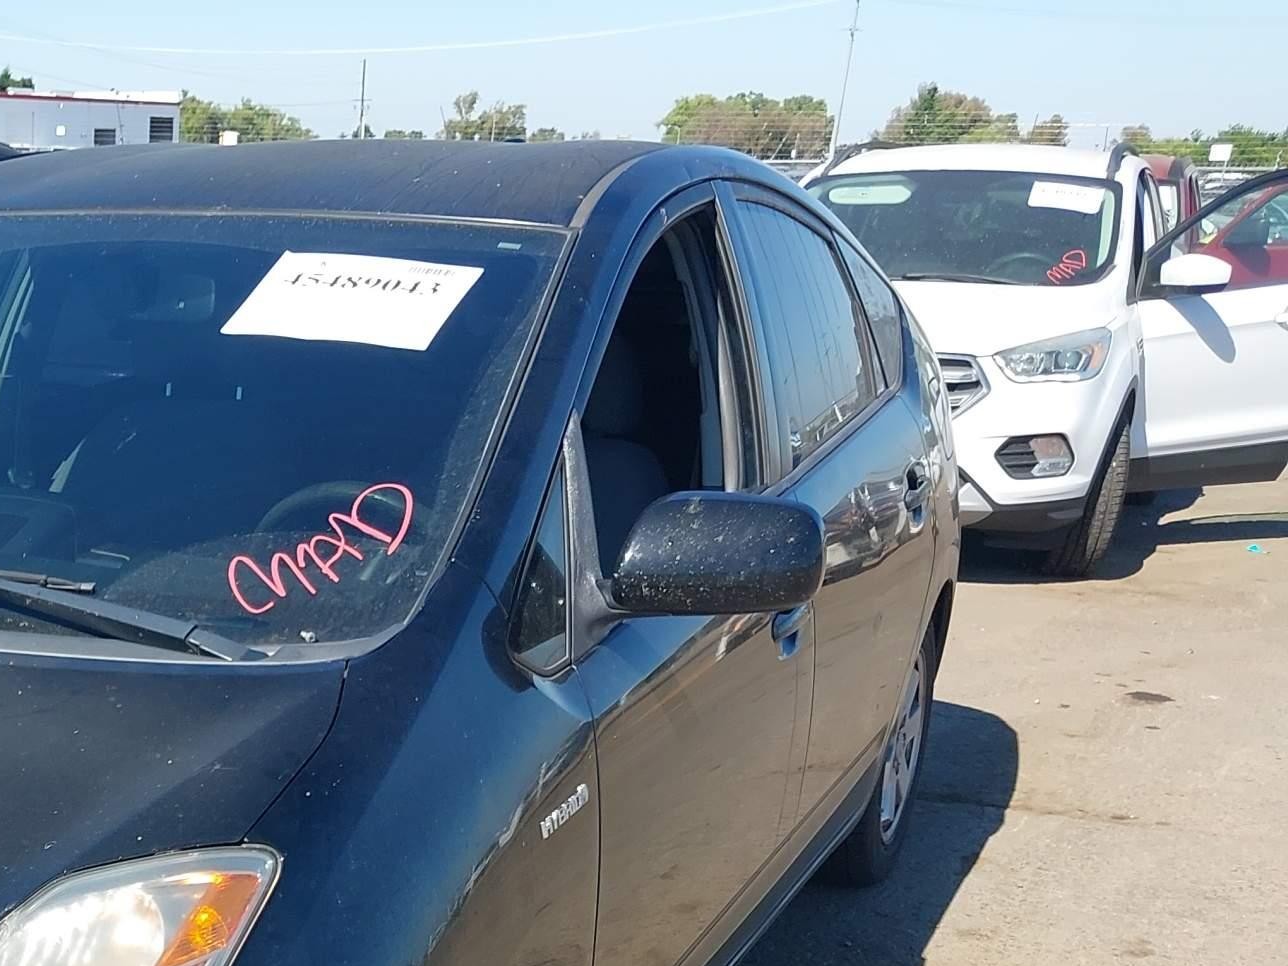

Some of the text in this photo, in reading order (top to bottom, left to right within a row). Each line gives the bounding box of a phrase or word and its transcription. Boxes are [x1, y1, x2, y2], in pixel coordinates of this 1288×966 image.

[1046, 250, 1086, 284] MAD
[284, 273, 440, 296] 45489043
[227, 482, 414, 615] MAD
